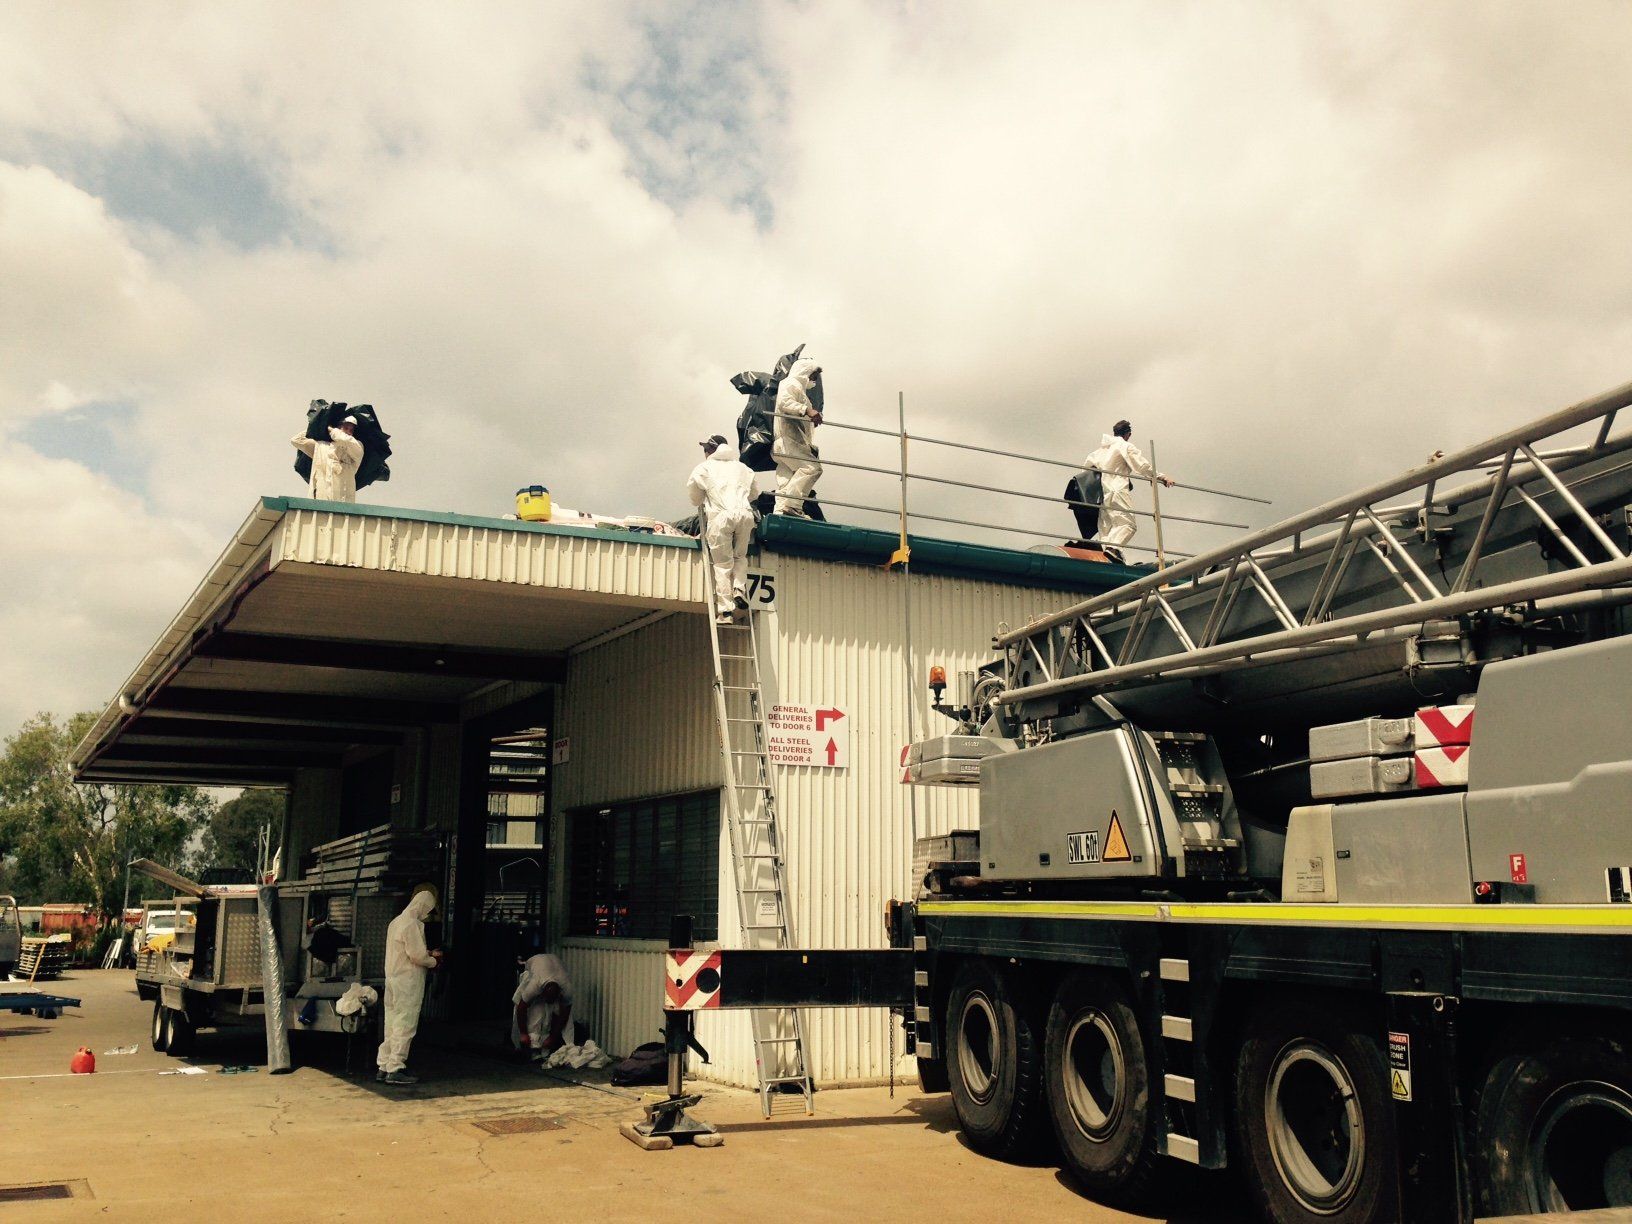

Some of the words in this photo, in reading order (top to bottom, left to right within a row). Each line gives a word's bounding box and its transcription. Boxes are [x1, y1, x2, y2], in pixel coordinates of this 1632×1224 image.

[747, 573, 775, 603] 75
[772, 705, 808, 714] GENERAL
[768, 713, 813, 723] DELIVERIES
[783, 723, 804, 731] DOOR
[770, 736, 784, 744] ALL
[787, 737, 811, 746] STEEL
[768, 745, 813, 755] DELIVERIES
[782, 754, 804, 762] DOOR
[1069, 835, 1084, 862] SWL
[1086, 834, 1098, 861] 60t
[1513, 856, 1522, 872] F
